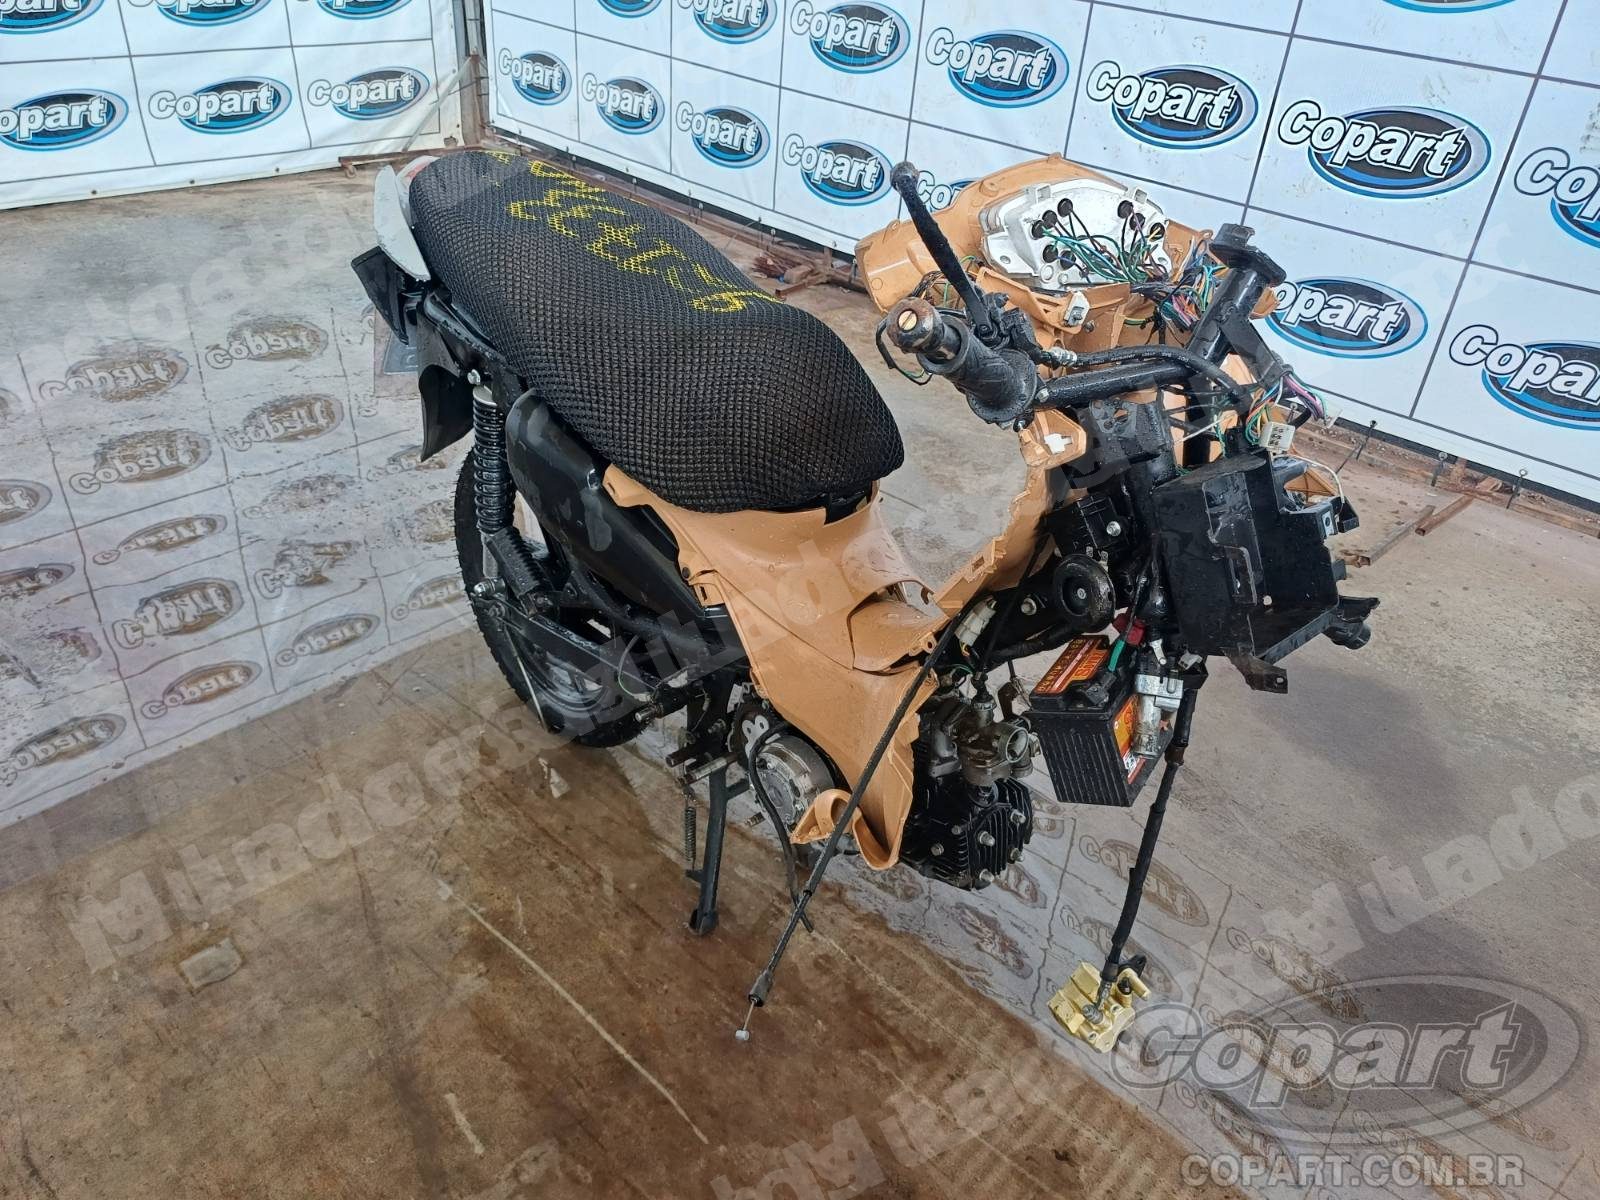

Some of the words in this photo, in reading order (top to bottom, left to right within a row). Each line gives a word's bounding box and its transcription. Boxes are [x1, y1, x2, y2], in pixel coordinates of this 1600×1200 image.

[791, 0, 896, 56] Copart
[500, 48, 562, 94] Copart
[926, 27, 1052, 90] Copart
[0, 96, 106, 142] opart
[148, 84, 273, 125] Copart
[307, 74, 417, 109] Copart
[582, 73, 656, 121] Copart
[1086, 60, 1238, 131] Copart
[676, 101, 758, 155] Copart
[1278, 101, 1465, 177] Copart
[783, 133, 879, 192] Copart
[1272, 282, 1404, 343] opart
[1449, 324, 1600, 406] Copa
